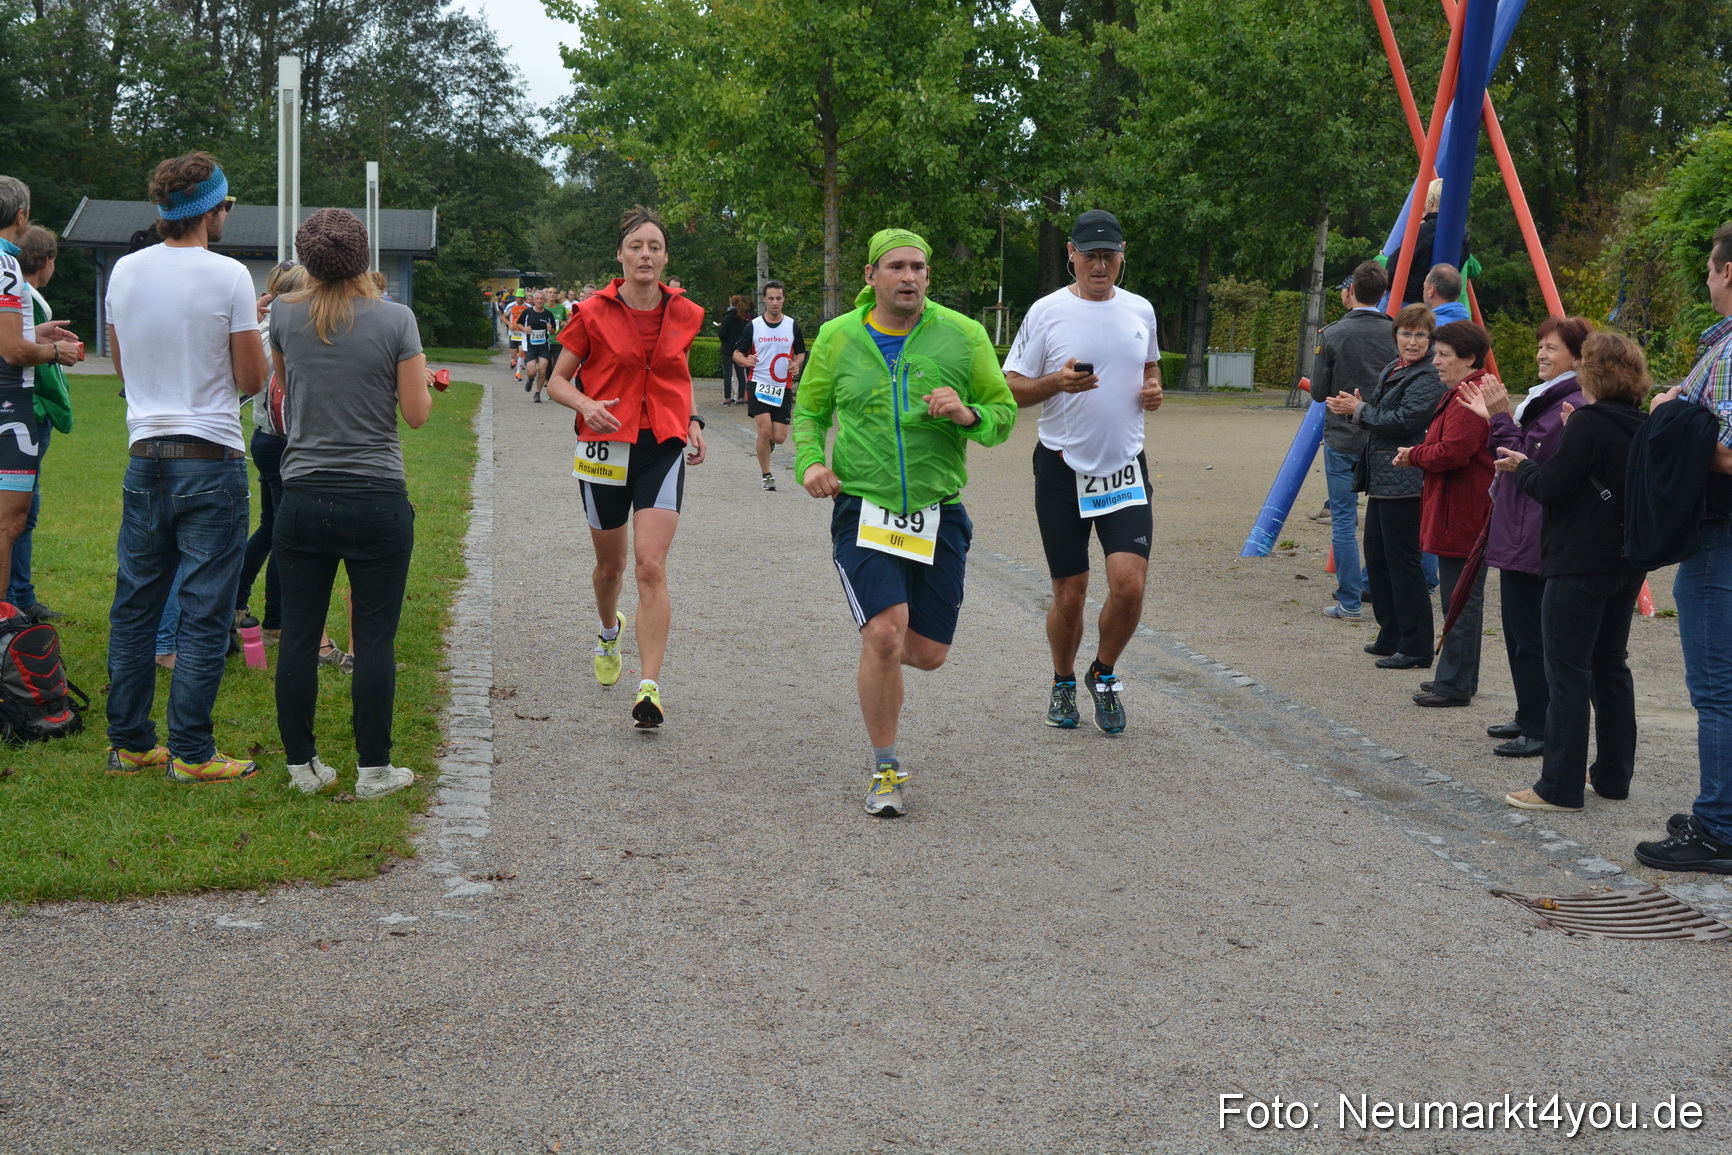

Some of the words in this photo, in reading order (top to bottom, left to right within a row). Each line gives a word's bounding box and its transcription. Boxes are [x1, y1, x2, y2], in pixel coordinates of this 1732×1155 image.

[758, 335, 789, 343] Oberbank
[758, 383, 782, 397] 2314
[145, 444, 185, 457] PMA
[585, 440, 610, 462] 86
[578, 461, 613, 477] Roswitha
[1083, 464, 1136, 494] 2109
[1092, 491, 1133, 508] Wolfgang
[879, 505, 925, 534] 139
[890, 534, 905, 547] Uli
